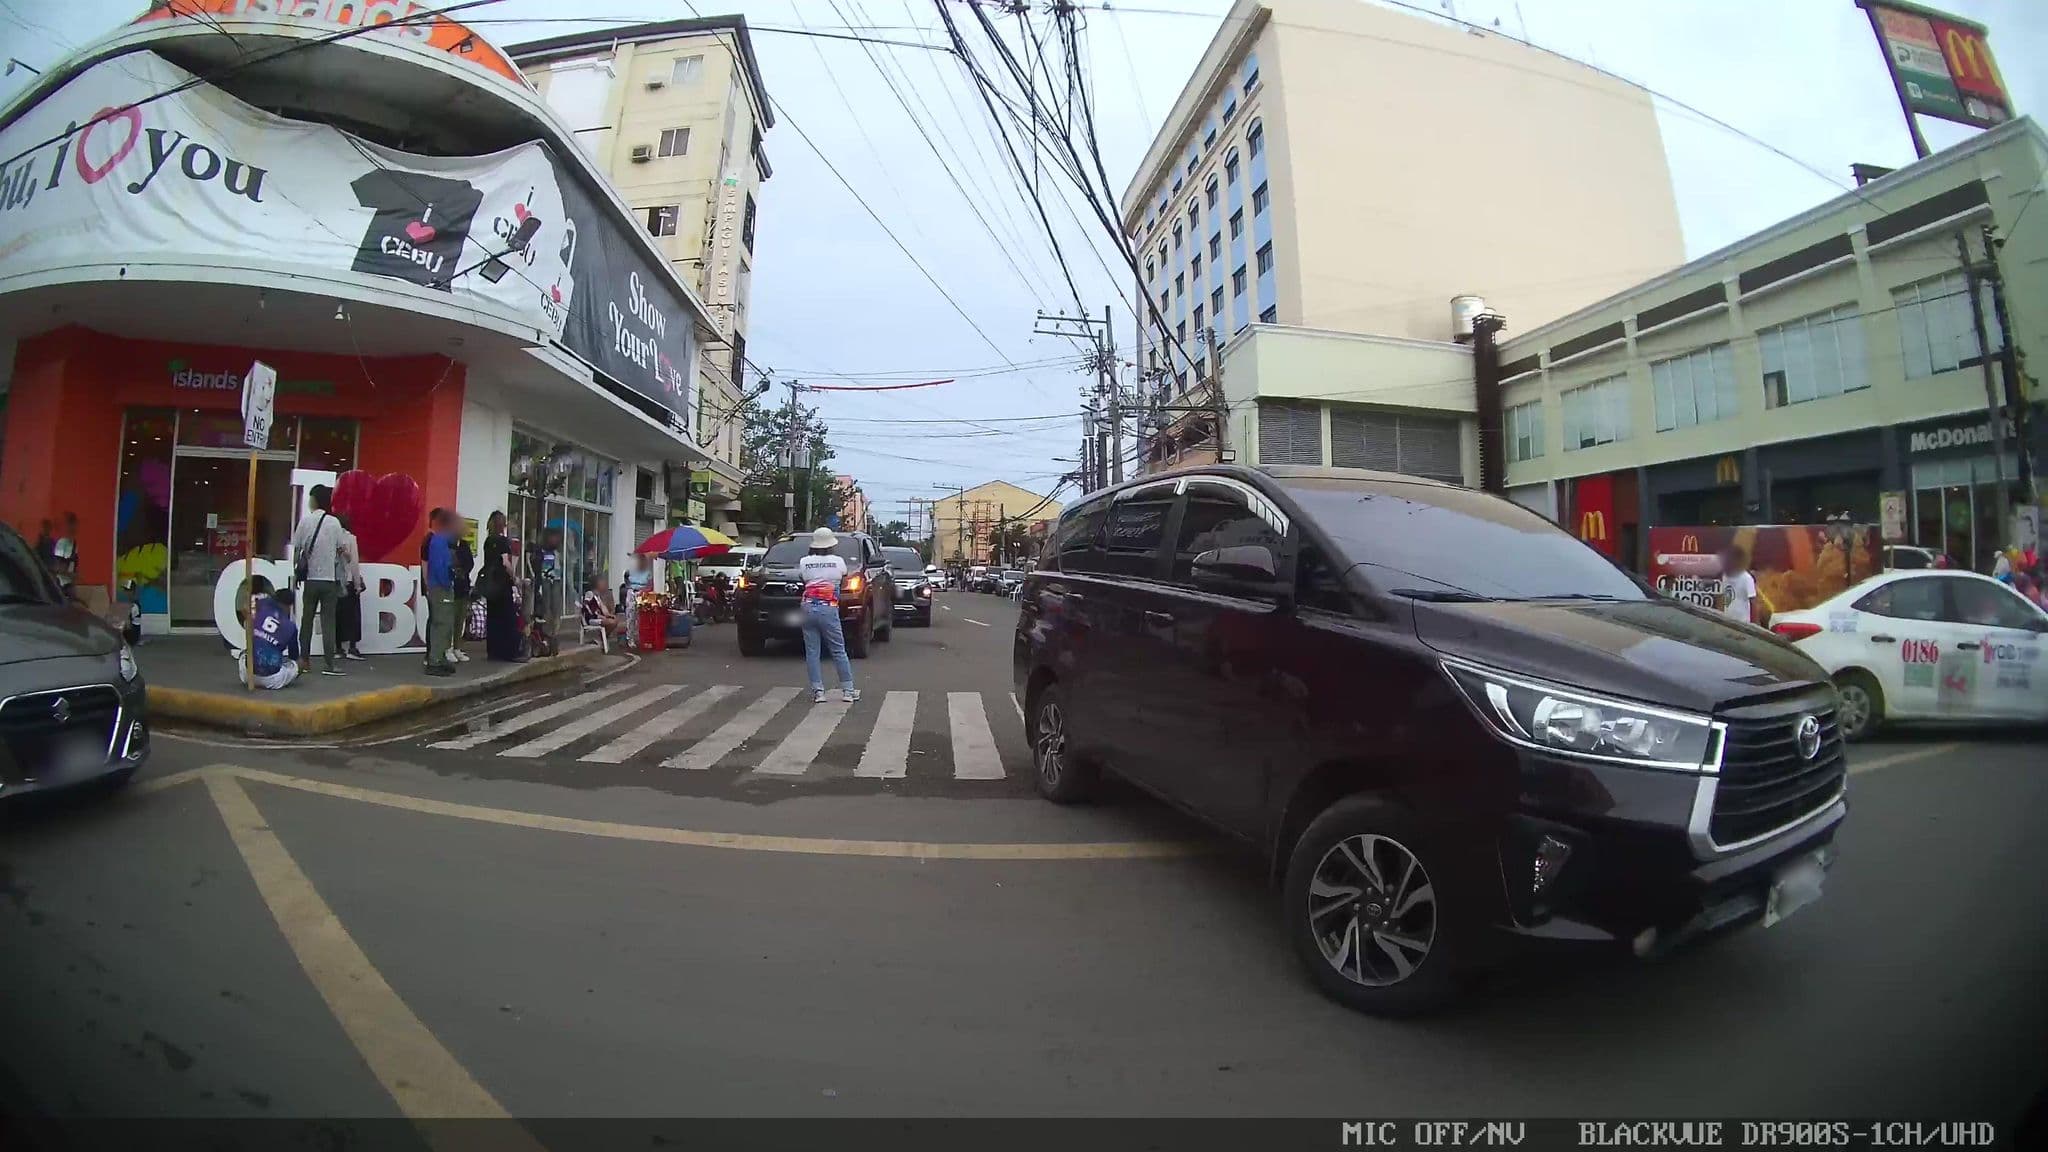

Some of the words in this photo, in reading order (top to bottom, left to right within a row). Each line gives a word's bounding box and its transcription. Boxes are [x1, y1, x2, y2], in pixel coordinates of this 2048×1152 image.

[127, 128, 268, 202] you
[380, 234, 444, 274] CEBU
[629, 271, 667, 340] Show
[609, 301, 648, 370] Your
[172, 368, 238, 390] islands
[252, 415, 265, 432] NO
[262, 615, 280, 634] 6
[1902, 638, 1940, 664] 0186
